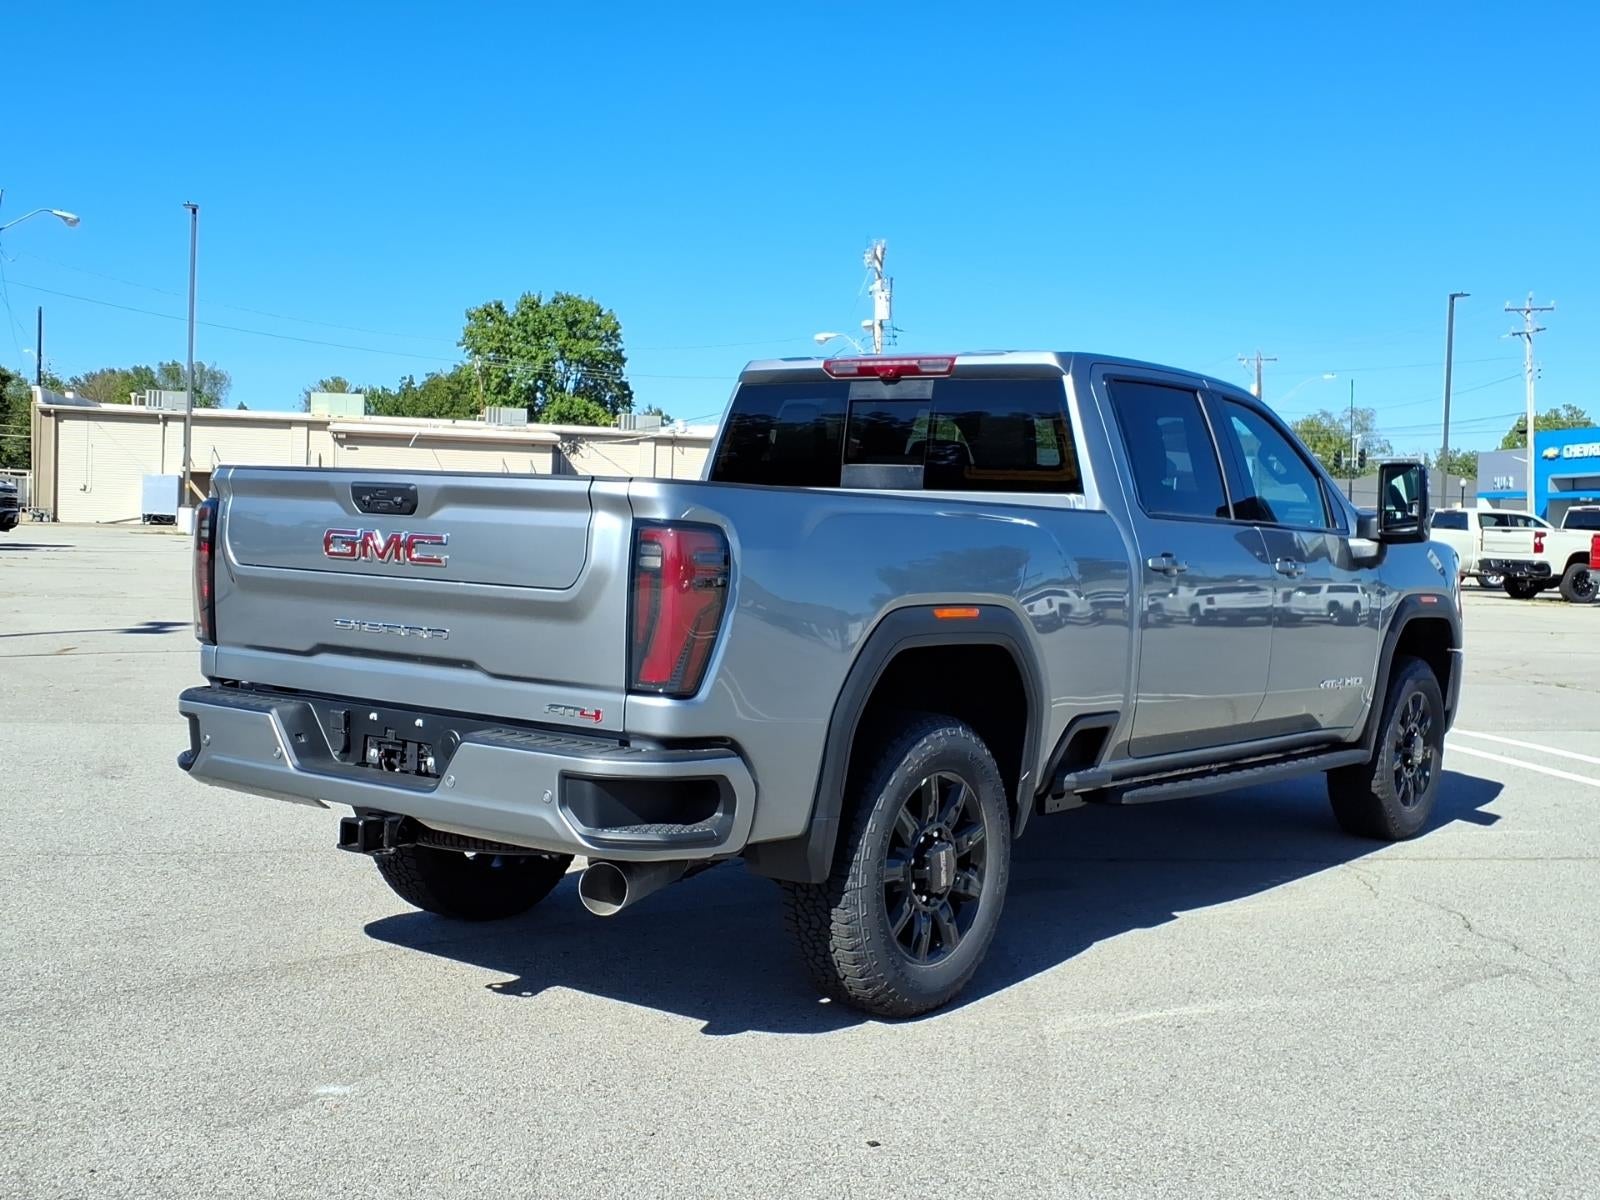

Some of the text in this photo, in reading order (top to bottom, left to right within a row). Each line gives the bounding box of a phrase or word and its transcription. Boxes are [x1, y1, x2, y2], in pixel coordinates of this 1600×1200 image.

[323, 528, 449, 567] GMC
[334, 618, 449, 640] SIERRA
[544, 703, 603, 724] AT4
